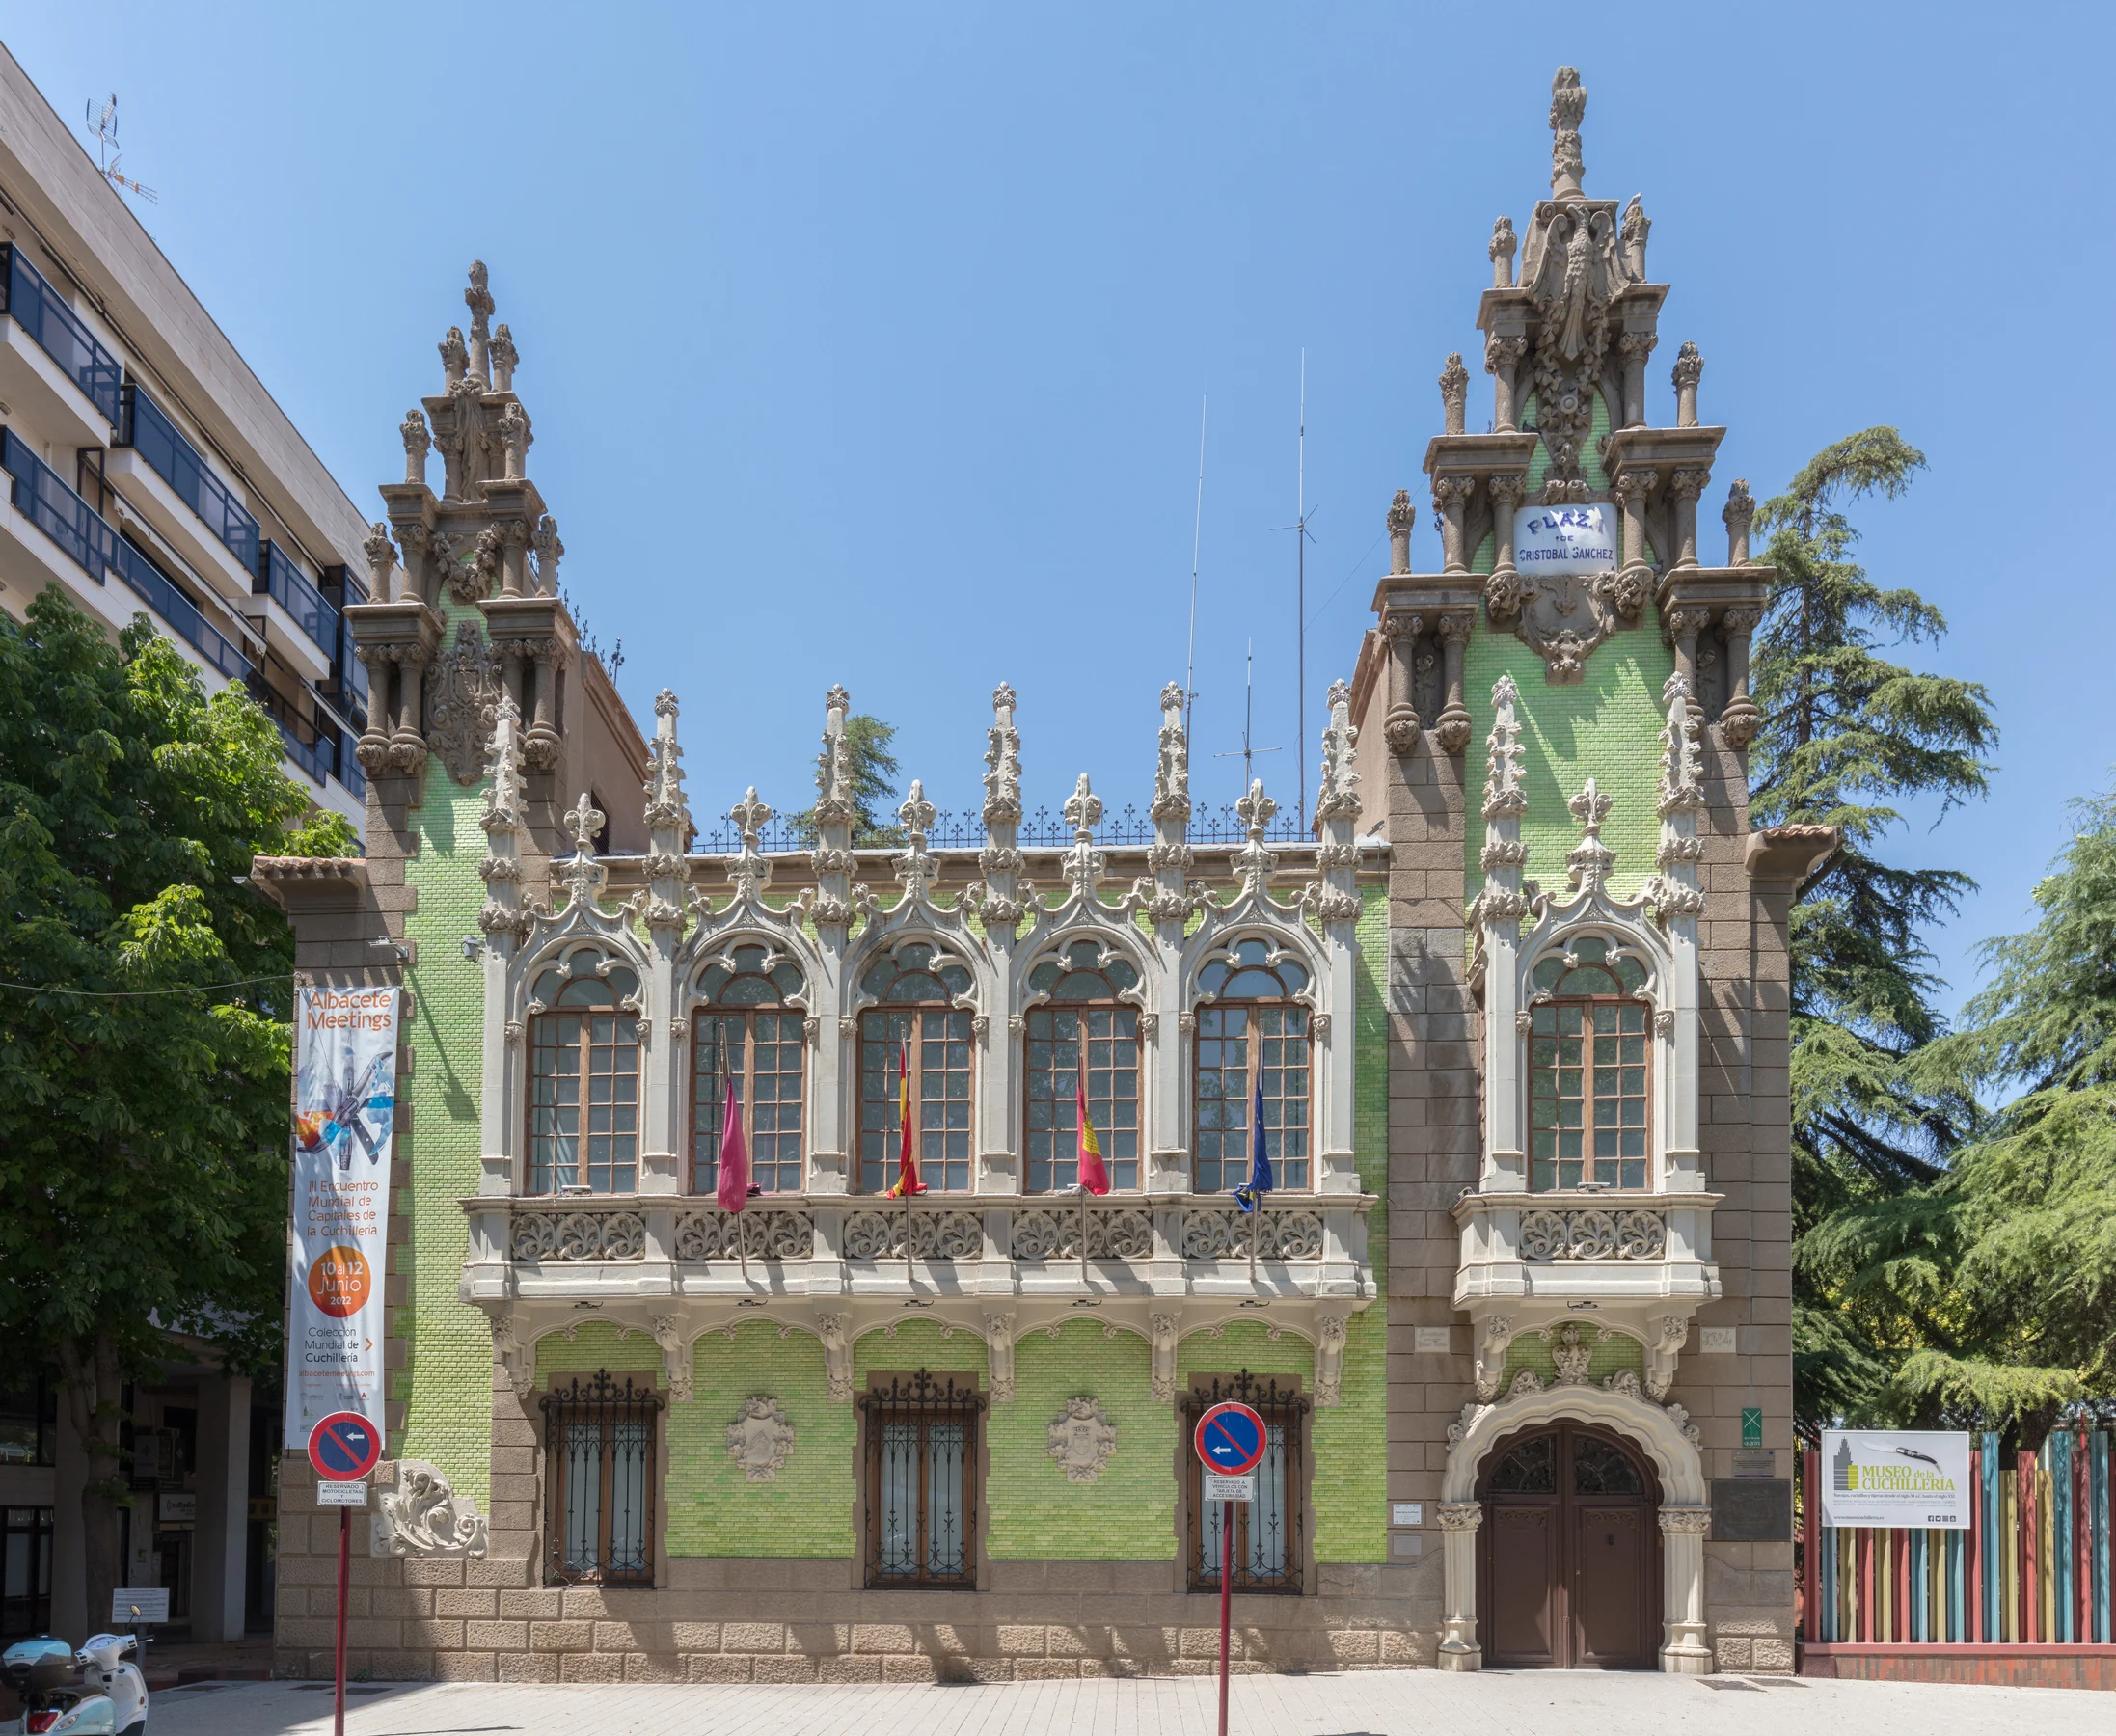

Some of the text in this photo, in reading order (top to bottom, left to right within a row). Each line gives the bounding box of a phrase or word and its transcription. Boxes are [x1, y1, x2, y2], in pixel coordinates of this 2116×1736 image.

[1519, 548, 1568, 561] CRISTOBAL
[309, 991, 392, 1010] Albacete
[307, 1011, 392, 1032] Meetings
[320, 1180, 378, 1192] Encuentro
[308, 1196, 372, 1207] Mundial de
[308, 1209, 376, 1223] Capitales de
[307, 1224, 377, 1236] la Cuchillería
[320, 1261, 363, 1276] 10 al 12
[316, 1276, 362, 1295] Junio
[330, 1296, 352, 1305] 2022
[308, 1326, 357, 1337] Colección
[305, 1340, 359, 1350] Mundial de
[305, 1352, 358, 1363] Cuchillería
[299, 1370, 375, 1378] albacetemeetings.com
[1862, 1465, 1912, 1478] MUSEO
[1862, 1476, 1955, 1491] CUCHILLERÍA
